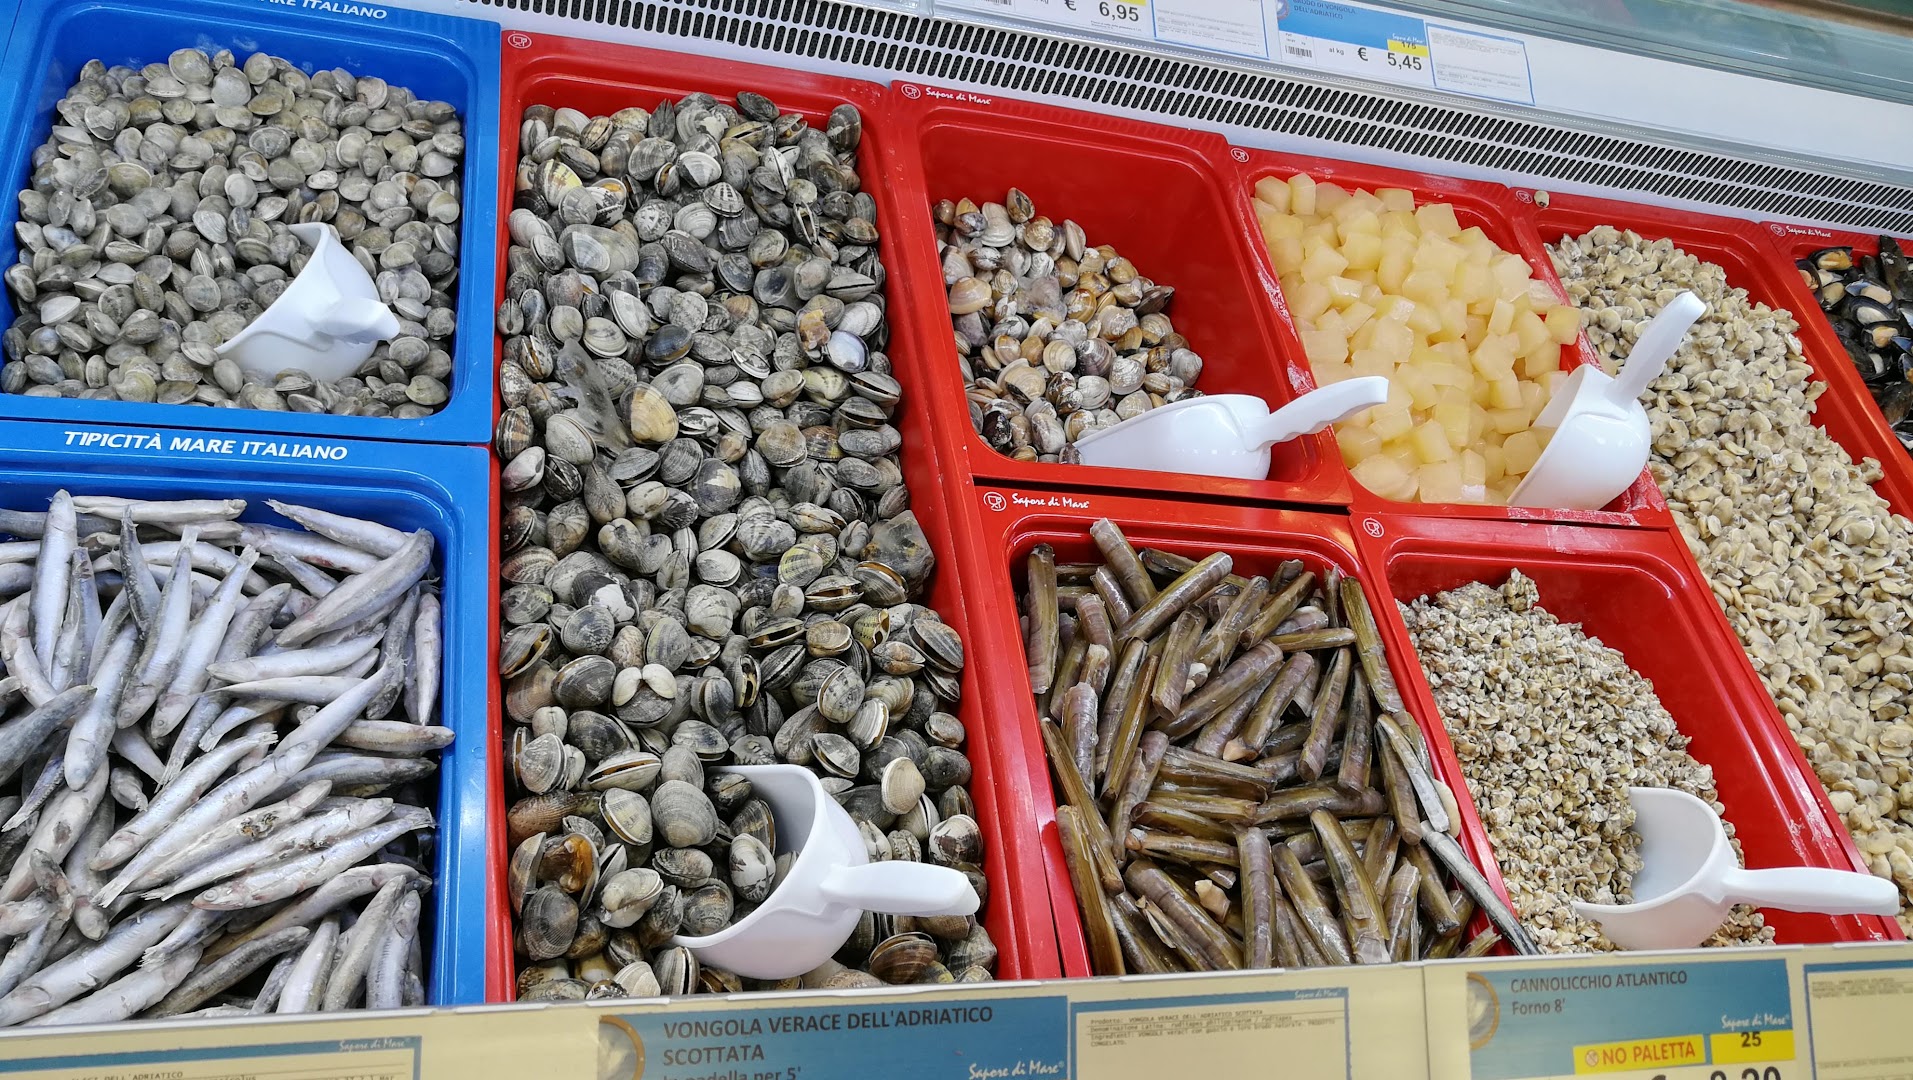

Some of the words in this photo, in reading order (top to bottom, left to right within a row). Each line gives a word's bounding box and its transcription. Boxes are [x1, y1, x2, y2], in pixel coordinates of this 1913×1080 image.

[302, 0, 387, 19] ITALIANO
[1099, 1, 1139, 21] 6,95
[1294, 5, 1343, 19] DELL'ADRIATICO
[1325, 3, 1356, 14] VONGOLA
[1357, 46, 1369, 61] €
[1387, 52, 1422, 70] 5,45
[925, 87, 954, 99] Sapore
[956, 92, 966, 101] di
[64, 431, 162, 450] TIPICITÀ
[170, 437, 236, 454] MARE
[241, 441, 348, 461] ITALIANO
[1011, 493, 1046, 508] Sapore
[1048, 496, 1060, 507] di
[1511, 974, 1612, 994] CANNOLICCHIO
[1615, 970, 1687, 987] ATLANTICO
[1512, 1001, 1551, 1016] Forno
[1554, 998, 1566, 1014] 8'
[664, 1018, 763, 1039] VONGOLA
[768, 1014, 842, 1034] VERACE
[847, 1006, 993, 1030] DELL'ADRIATICO
[1721, 1014, 1750, 1032] Sapore
[1751, 1012, 1763, 1027] di
[1741, 1031, 1762, 1048] 25
[663, 1044, 765, 1066] SCOTTATA
[1603, 1047, 1627, 1065] NO
[1633, 1041, 1696, 1062] PALETTA
[968, 1063, 1009, 1080] Sapore
[1012, 1061, 1026, 1076] di
